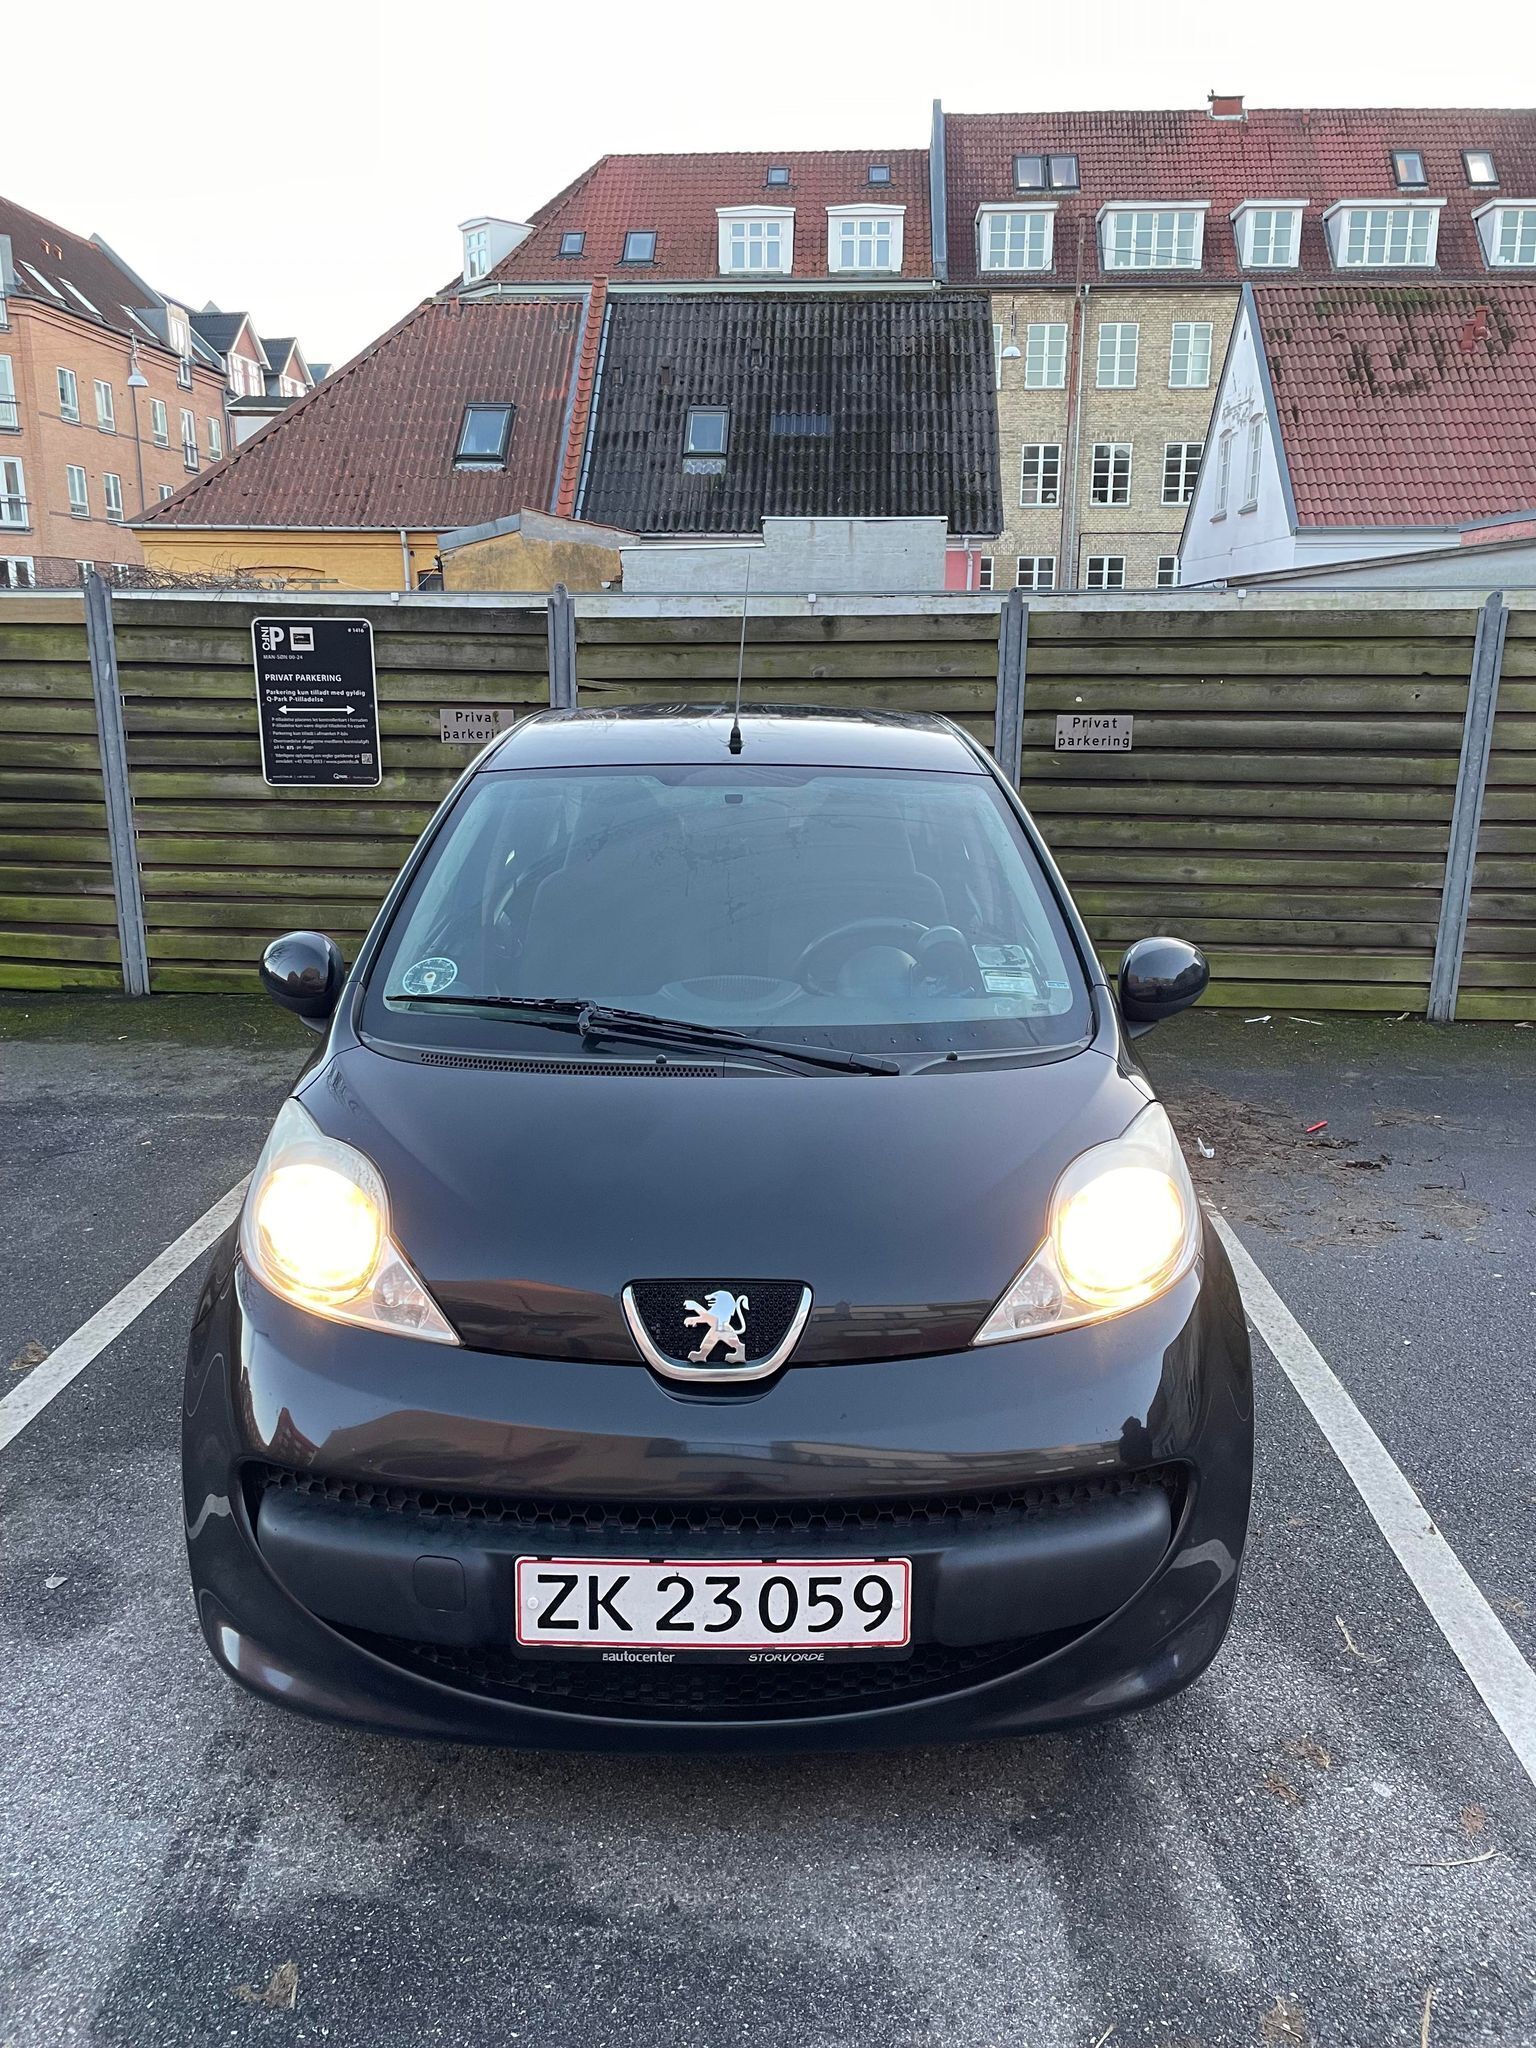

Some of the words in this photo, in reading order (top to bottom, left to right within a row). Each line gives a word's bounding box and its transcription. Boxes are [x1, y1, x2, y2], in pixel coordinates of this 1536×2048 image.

[261, 626, 270, 651] INFO
[270, 626, 284, 651] P
[295, 674, 342, 682] PARKERING
[455, 711, 499, 722] Privat
[1073, 717, 1117, 728] Privat
[444, 729, 500, 740] parkeri
[1058, 736, 1129, 748] parkering
[537, 1573, 633, 1632] ZK
[655, 1576, 742, 1633] 23
[758, 1575, 894, 1634] 059
[748, 1653, 824, 1662] STORVORDE
